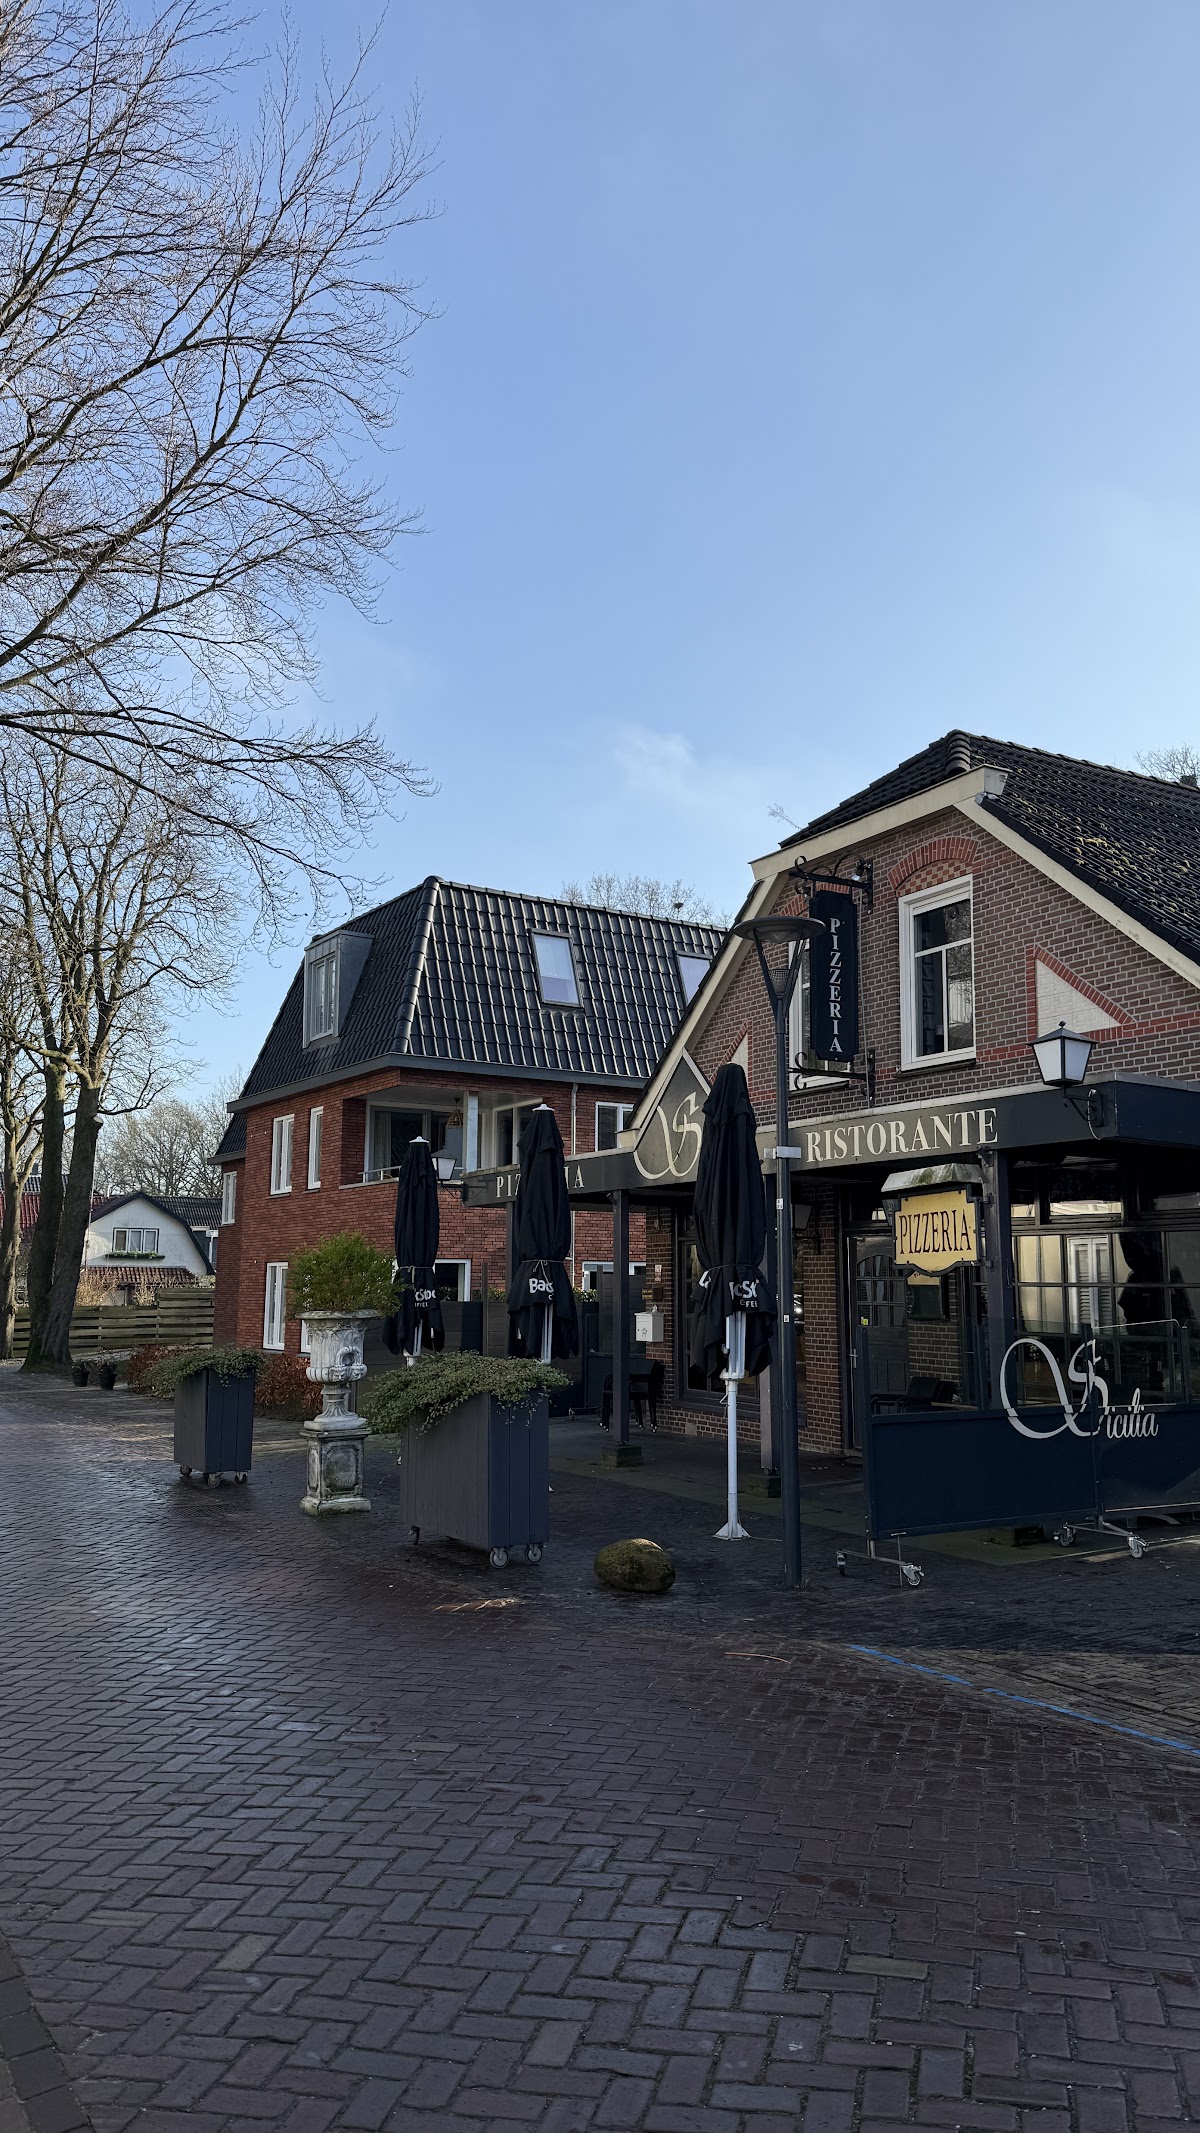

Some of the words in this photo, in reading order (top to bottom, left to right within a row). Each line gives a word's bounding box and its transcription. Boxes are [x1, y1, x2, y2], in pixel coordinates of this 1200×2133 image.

[829, 917, 843, 1053] PIZZERIA
[805, 1107, 998, 1163] RISTORANTE
[898, 1208, 972, 1254] PIZZERIA
